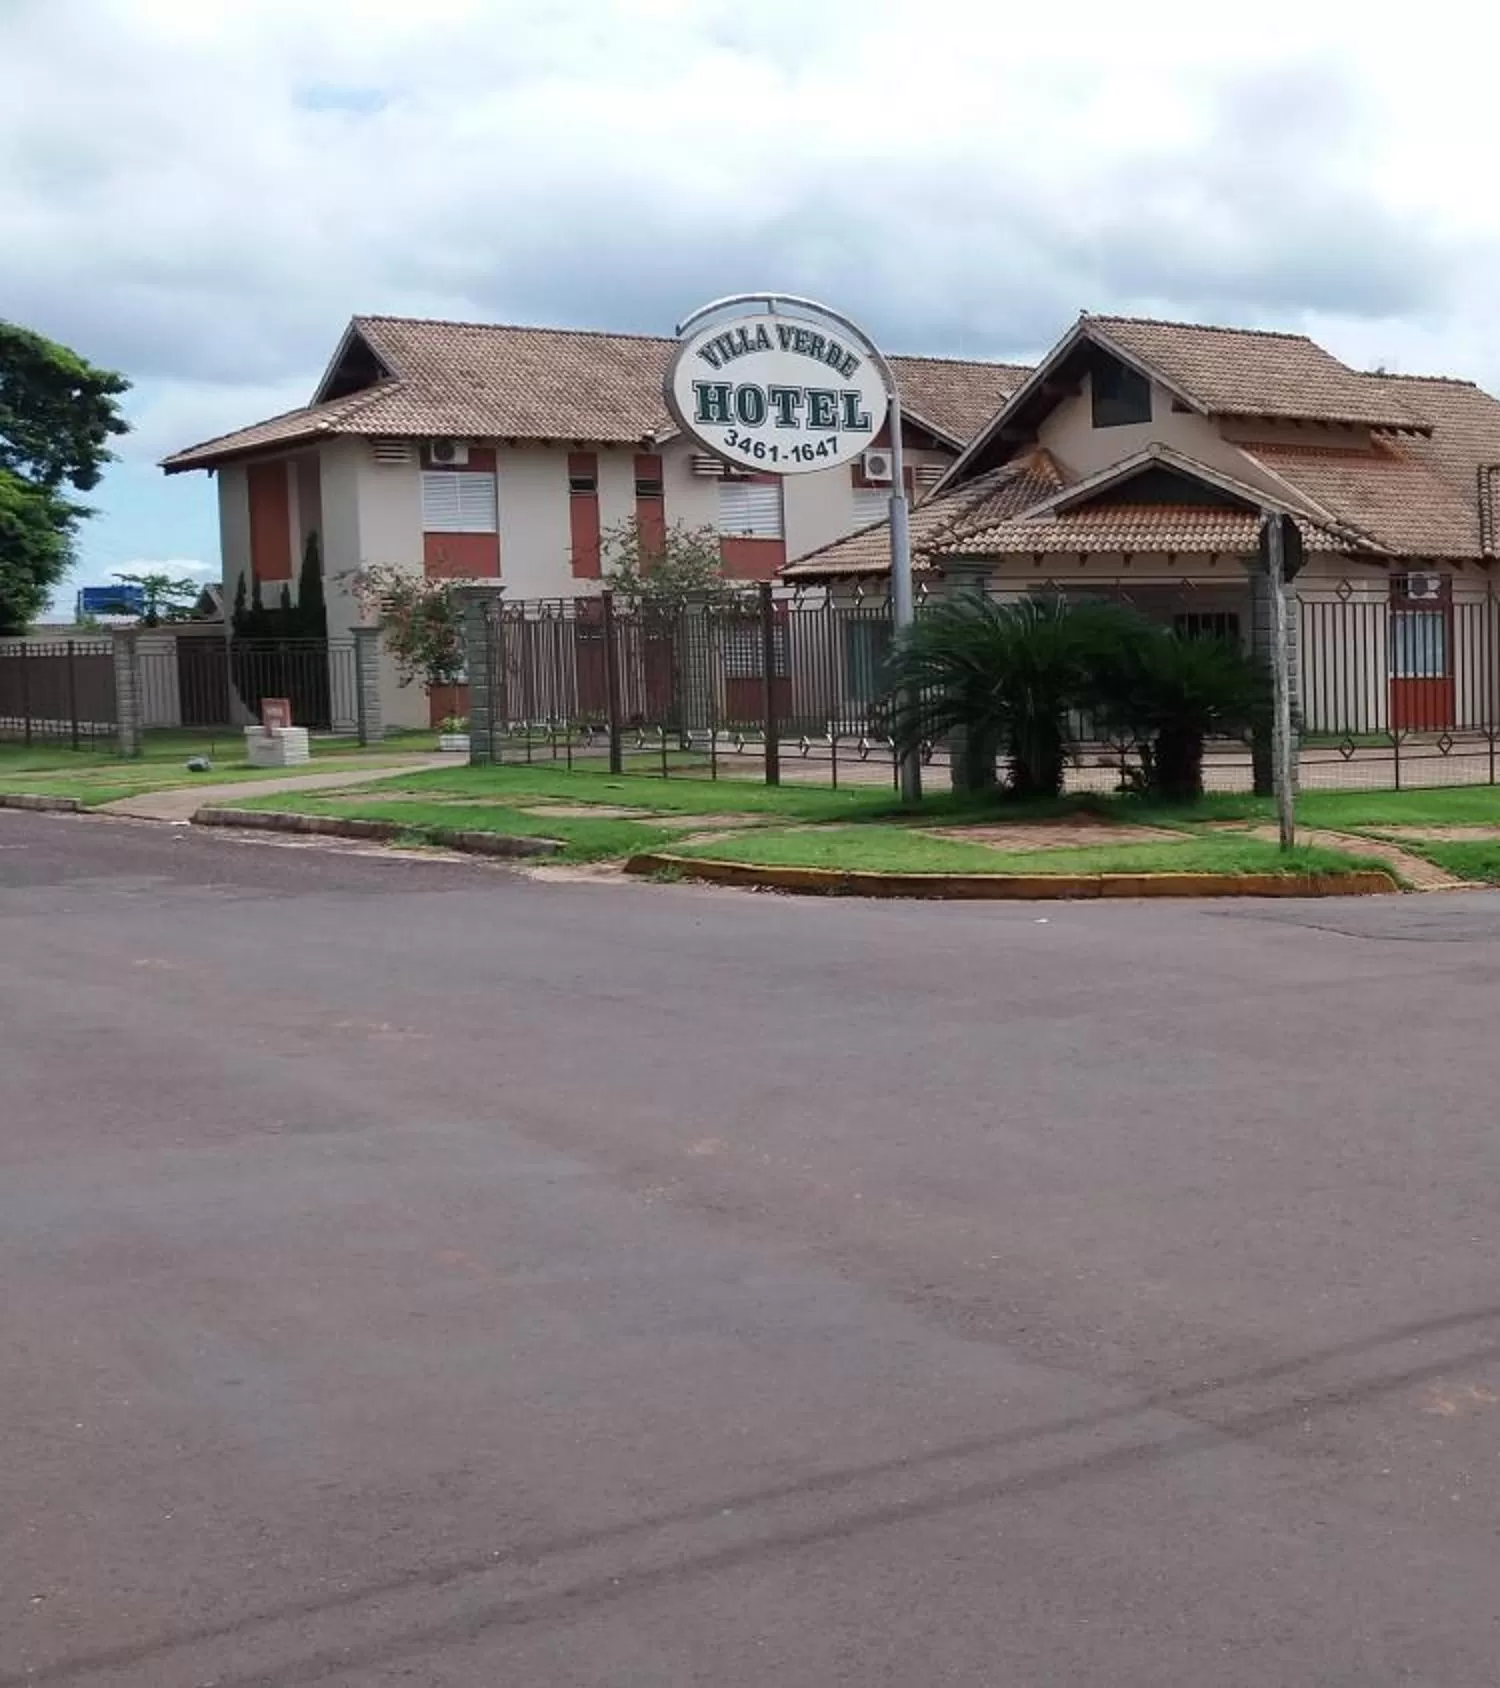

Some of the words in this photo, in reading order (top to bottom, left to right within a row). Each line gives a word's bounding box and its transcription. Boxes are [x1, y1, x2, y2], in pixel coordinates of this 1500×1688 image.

[696, 323, 774, 370] VILLA
[776, 323, 862, 380] VERDE
[692, 380, 872, 432] HOTEL
[724, 429, 839, 463] 3461-1647
